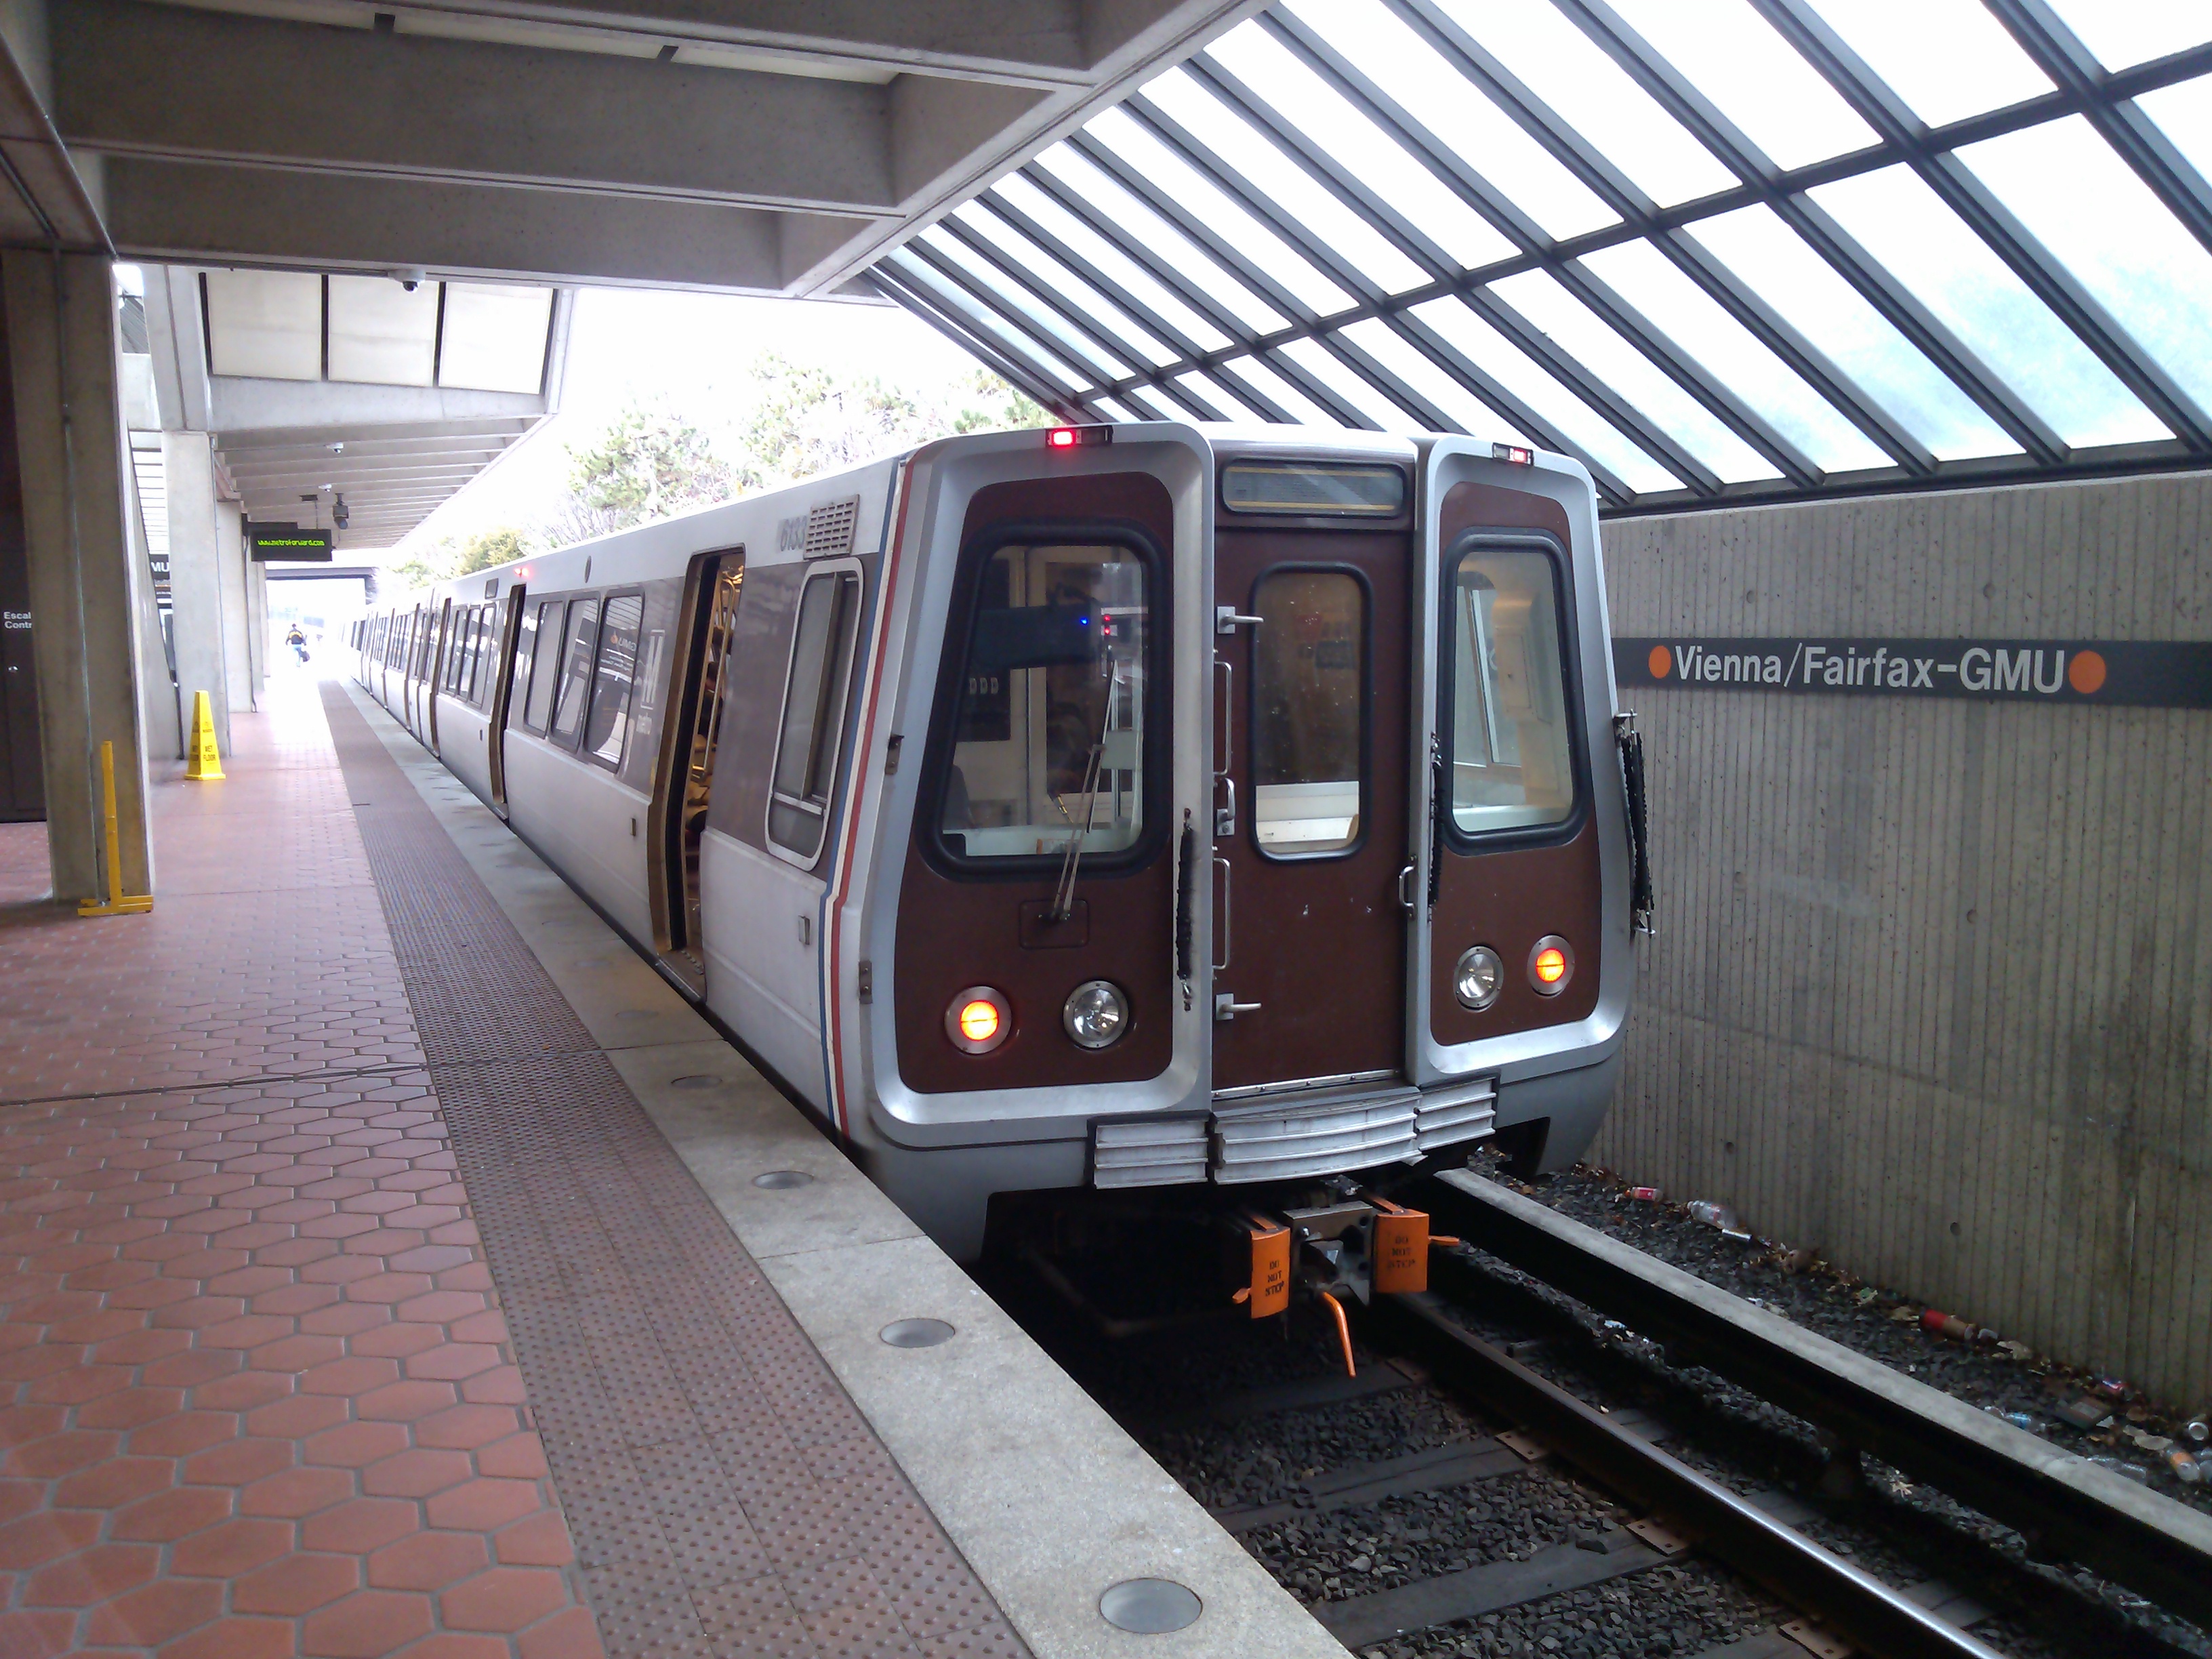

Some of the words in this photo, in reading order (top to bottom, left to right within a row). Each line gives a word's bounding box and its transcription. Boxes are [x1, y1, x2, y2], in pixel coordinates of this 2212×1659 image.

[1675, 642, 2065, 693] Vienna/Fairfax-GMU
[1267, 1270, 1282, 1282] NOT
[1265, 1280, 1284, 1296] STEP
